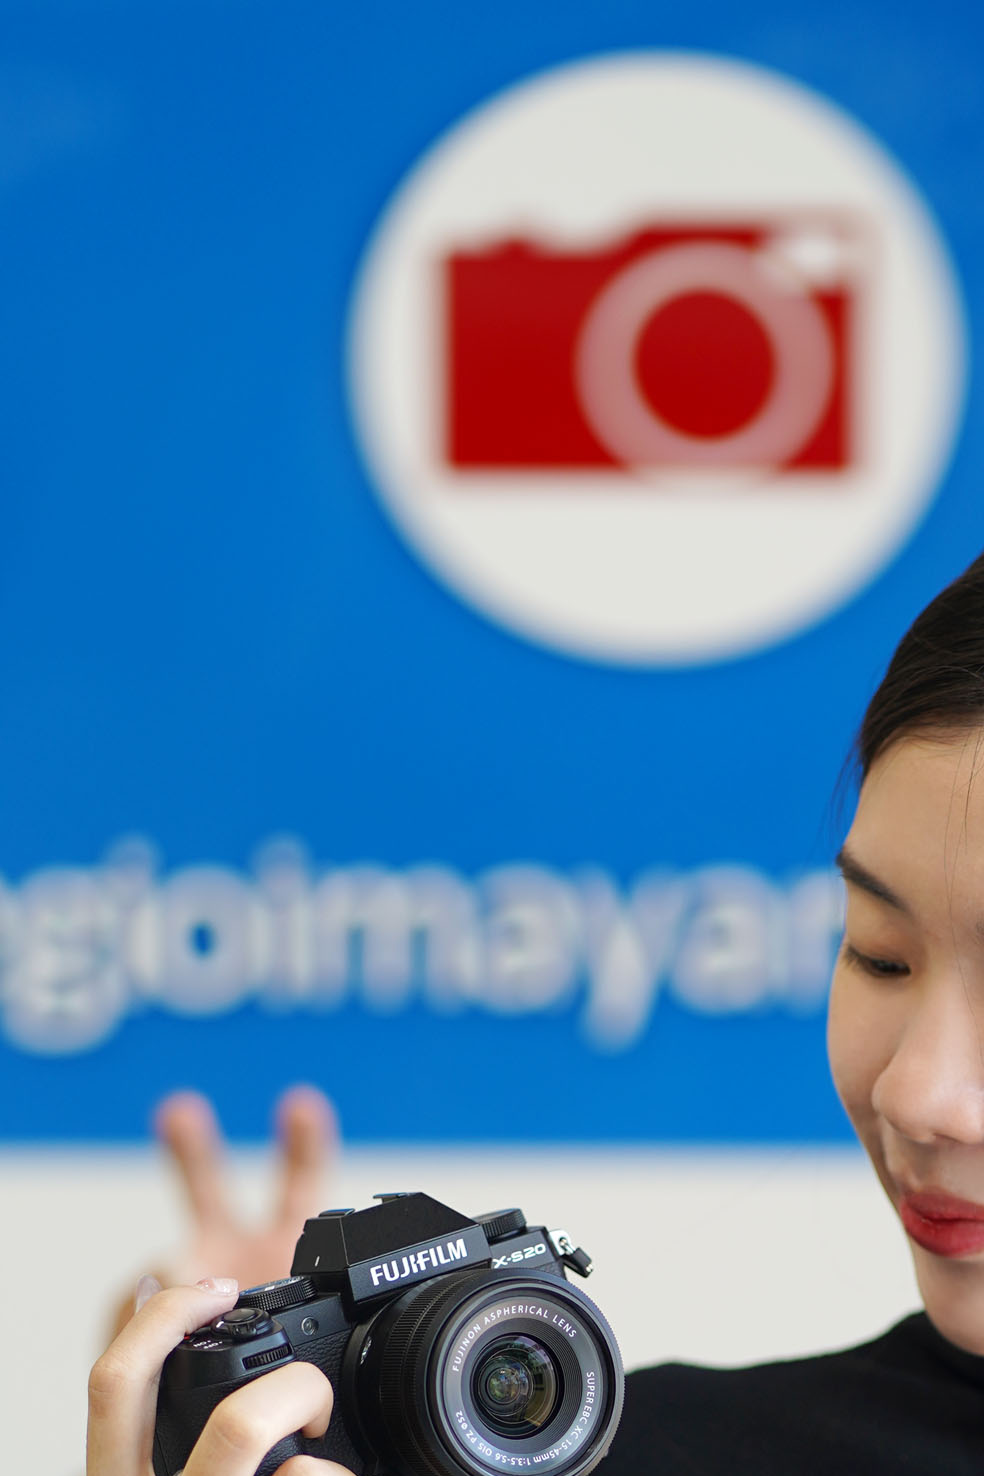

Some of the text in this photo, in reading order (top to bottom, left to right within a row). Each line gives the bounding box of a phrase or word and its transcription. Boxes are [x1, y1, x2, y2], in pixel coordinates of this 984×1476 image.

[369, 1238, 468, 1286] FUJIFILM
[492, 1243, 546, 1269] X-S20
[452, 1304, 577, 1372] FUJINON ASPHERICAL LENS
[584, 1371, 595, 1404] SUPER
[579, 1404, 593, 1425] EBC
[465, 1430, 477, 1444] PZ
[570, 1426, 583, 1440] XC
[477, 1442, 493, 1457] OIS
[533, 1438, 572, 1464] 15-45mm
